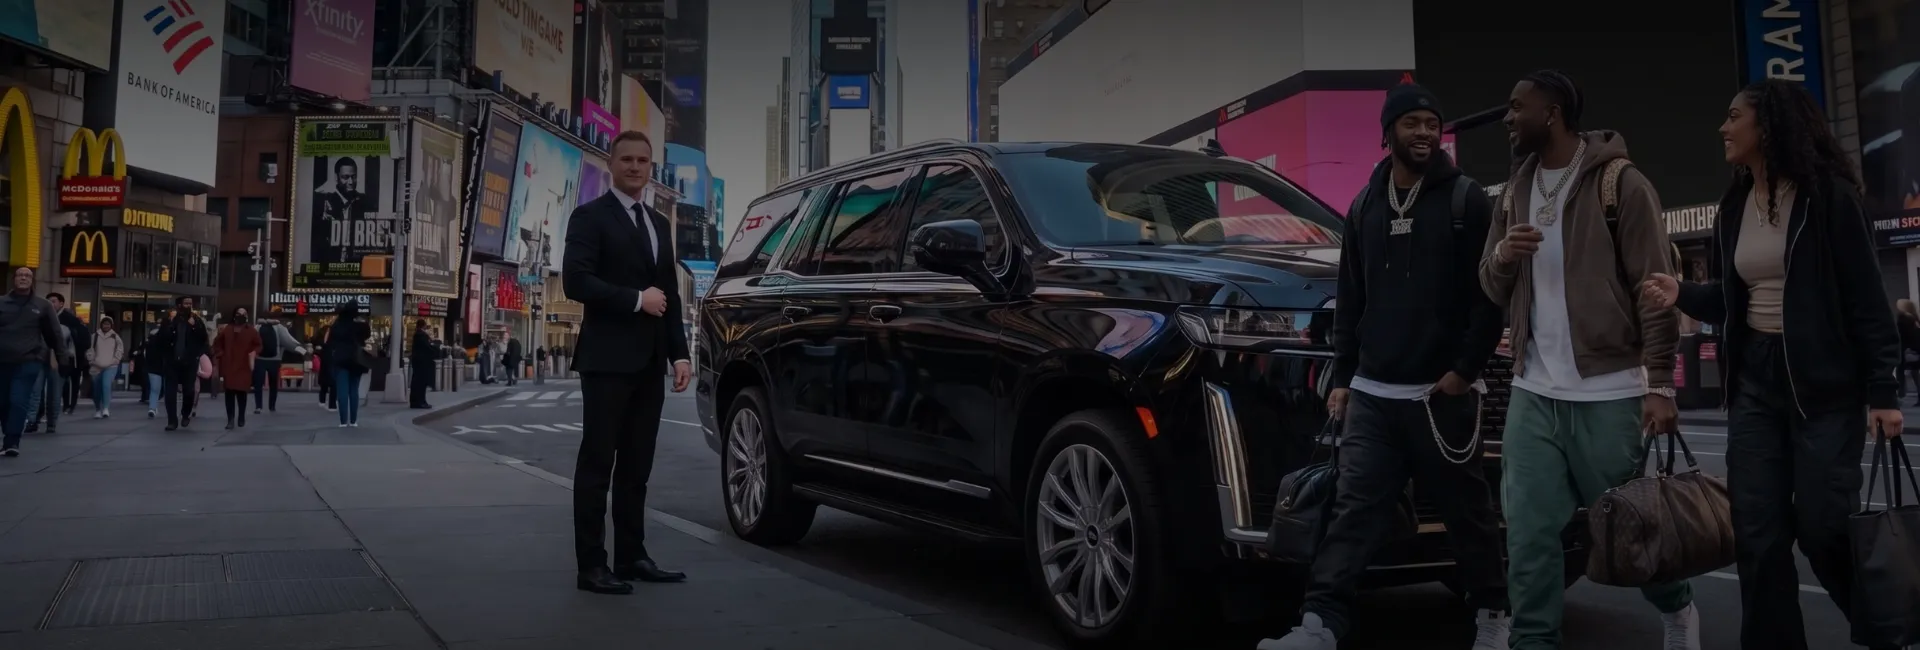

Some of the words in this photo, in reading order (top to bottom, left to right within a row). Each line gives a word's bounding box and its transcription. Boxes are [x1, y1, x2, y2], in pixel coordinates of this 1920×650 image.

[127, 71, 159, 96] BANK
[160, 84, 175, 100] OF
[175, 90, 217, 116] AMERICA
[61, 184, 121, 194] McDonald's
